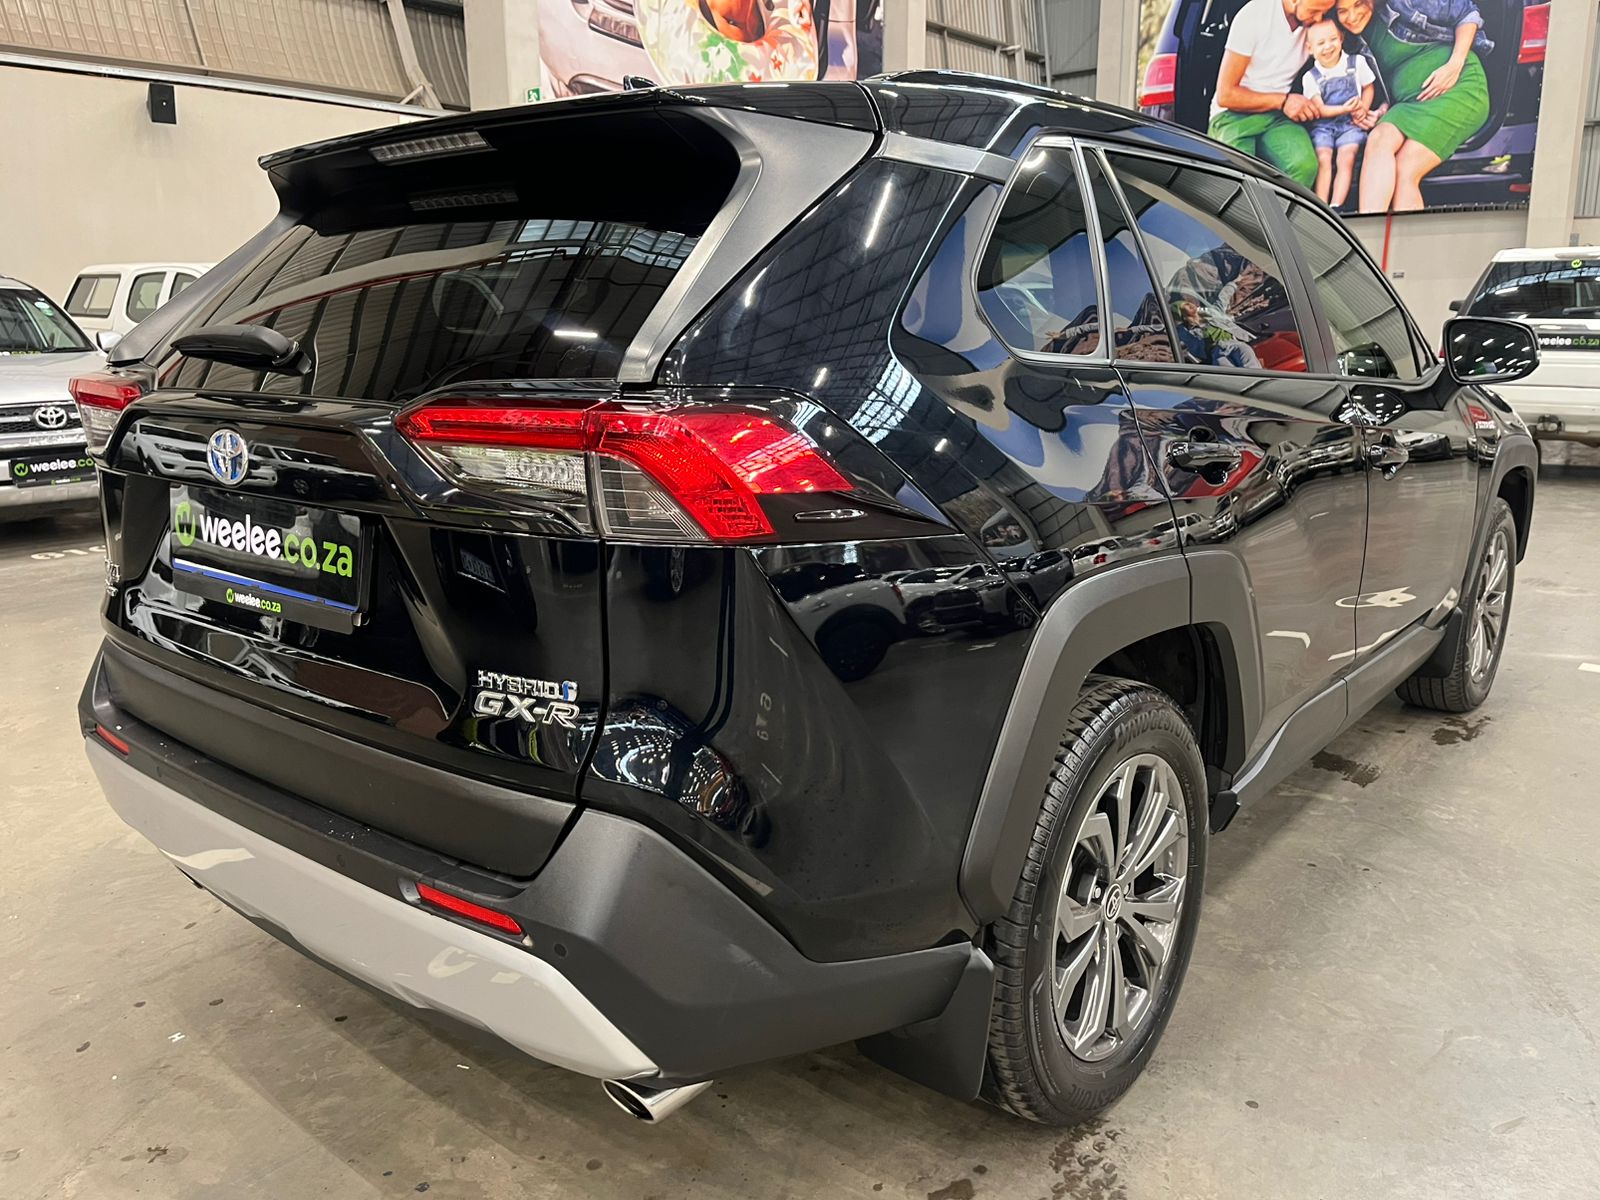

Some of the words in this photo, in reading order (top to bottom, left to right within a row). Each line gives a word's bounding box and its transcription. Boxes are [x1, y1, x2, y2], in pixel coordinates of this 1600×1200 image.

[30, 458, 94, 474] weelee.co
[199, 513, 353, 578] weelee.co.za
[477, 668, 560, 700] HYBRID
[473, 690, 580, 729] GX-R
